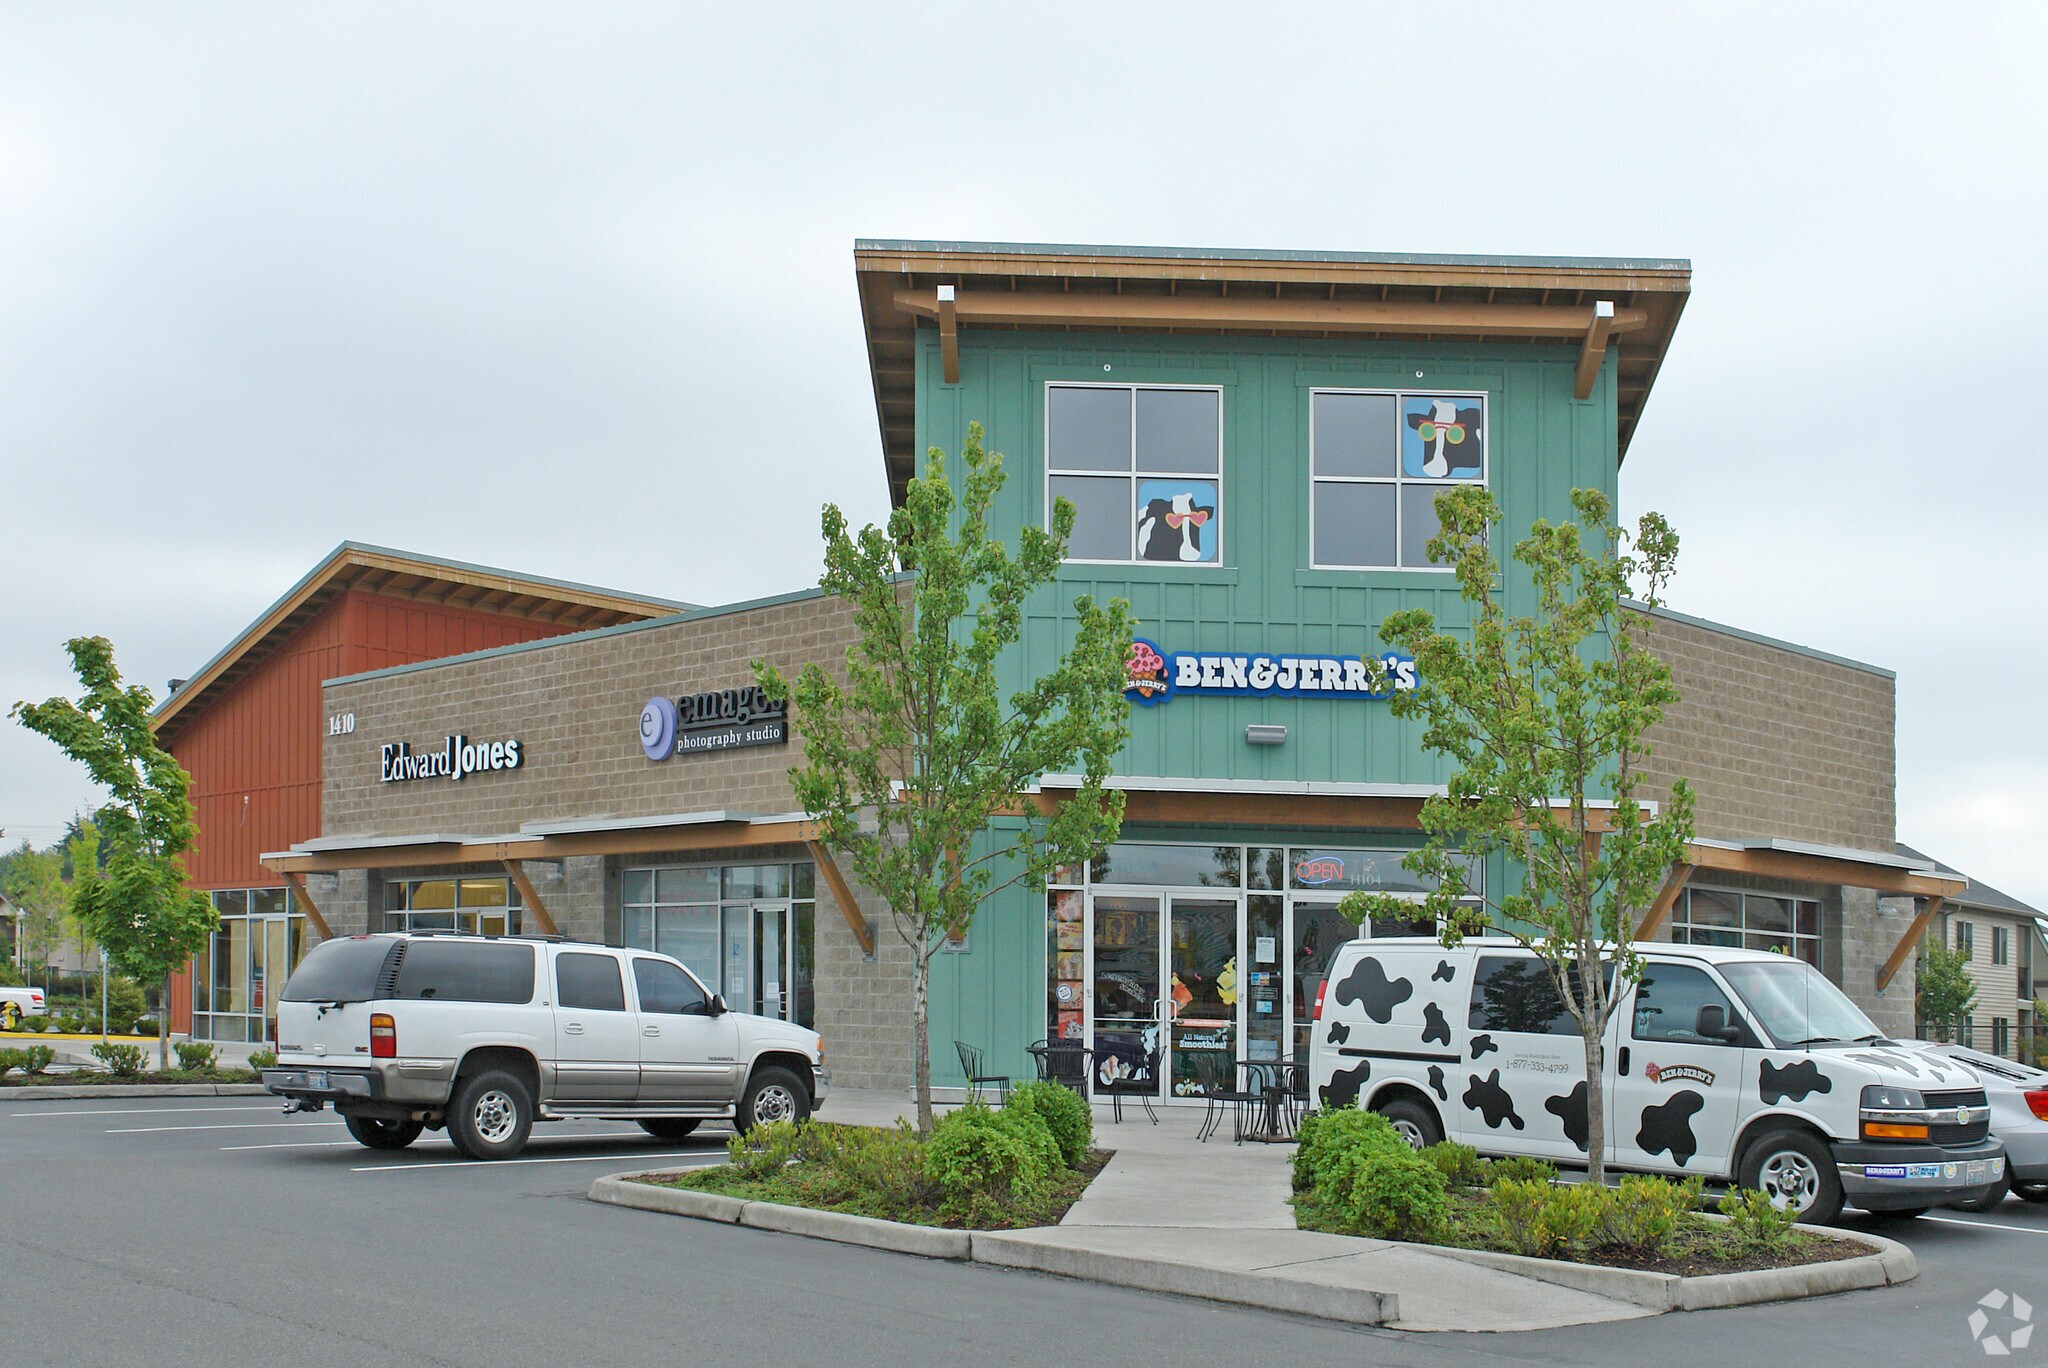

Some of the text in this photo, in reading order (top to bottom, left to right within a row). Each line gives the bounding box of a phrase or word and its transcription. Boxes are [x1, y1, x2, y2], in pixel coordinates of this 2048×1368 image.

[1121, 679, 1167, 692] EN&JERRY'S
[329, 713, 355, 736] 1410
[677, 725, 781, 752] photography studio
[380, 734, 519, 782] Edward Jones
[1296, 862, 1343, 879] OPEN
[1350, 874, 1382, 886] H104
[1179, 1040, 1227, 1049] Smoothies!
[1183, 1033, 1193, 1041] All
[1506, 1059, 1569, 1074] 1-877-333-4799
